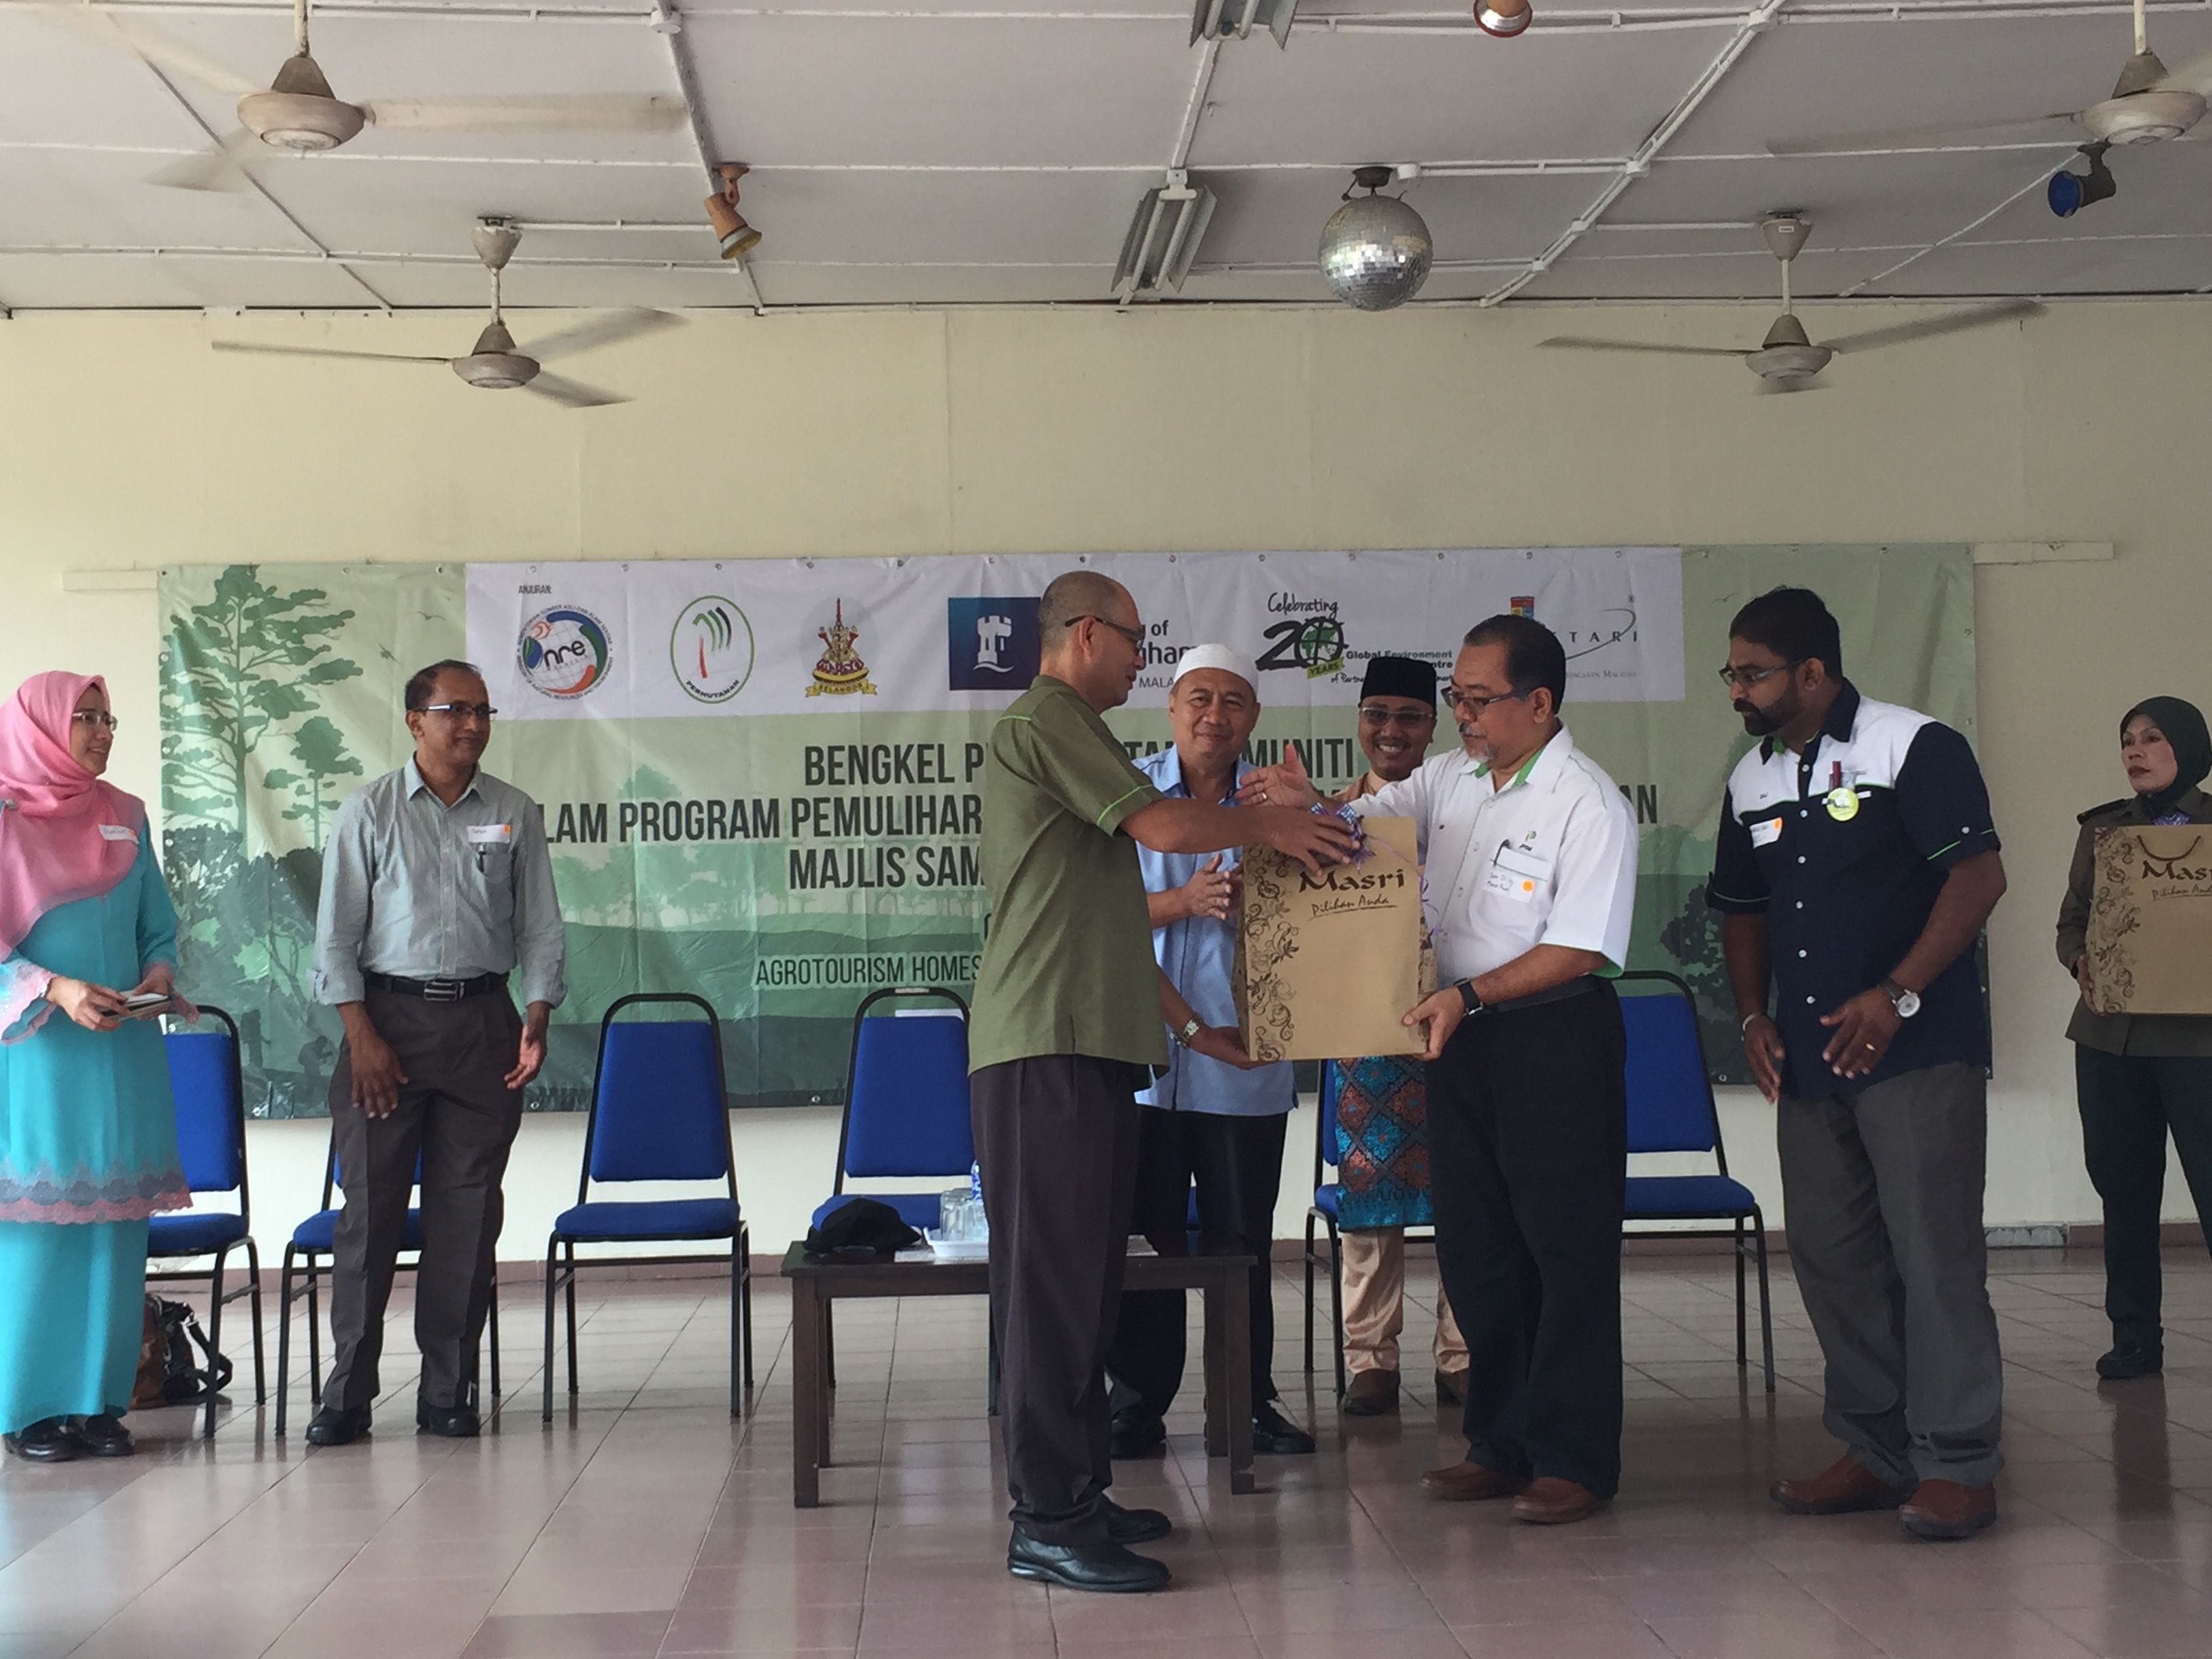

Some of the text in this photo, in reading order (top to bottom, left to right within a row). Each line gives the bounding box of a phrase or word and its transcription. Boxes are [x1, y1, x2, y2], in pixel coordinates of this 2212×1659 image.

[1268, 592, 1338, 619] Celebrating
[1151, 619, 1170, 636] of
[544, 640, 586, 671] nre
[1346, 651, 1452, 659] Global Environment
[805, 743, 956, 785] BENGKEL
[619, 798, 780, 842] PROGRAM
[792, 794, 982, 838] PEMULIHAR
[790, 846, 906, 890] MAJLIS
[1299, 868, 1405, 893] Masri
[1311, 894, 1389, 916] Pilihan Anda
[756, 956, 904, 985] AGROTOURISM
